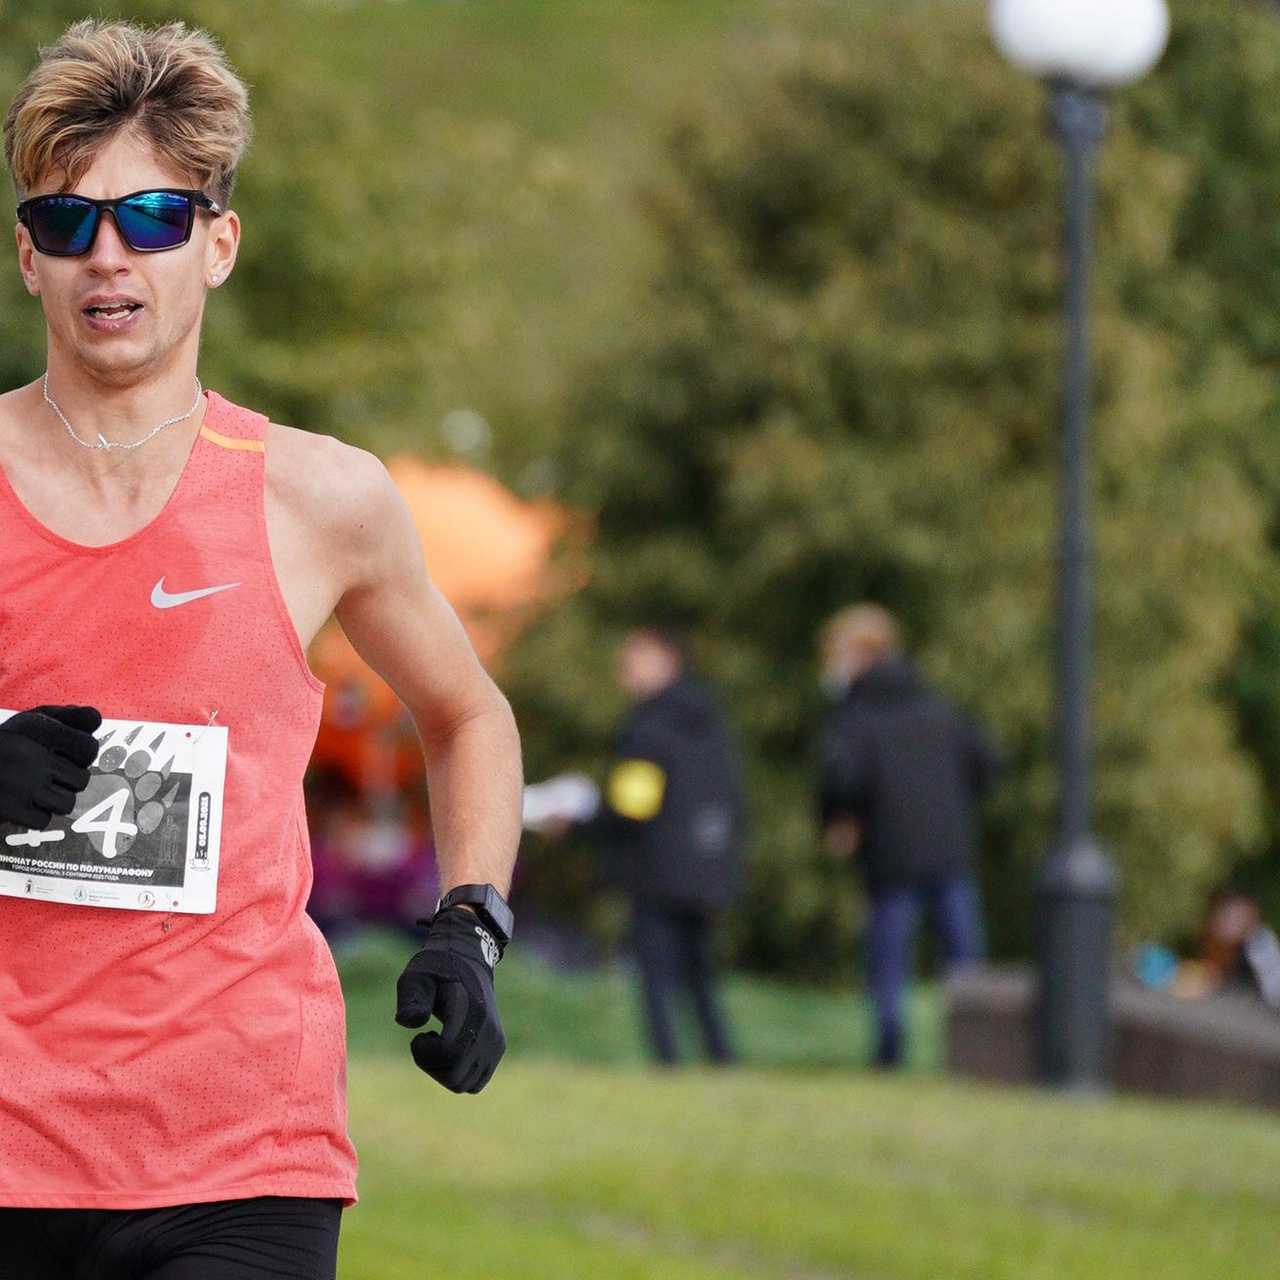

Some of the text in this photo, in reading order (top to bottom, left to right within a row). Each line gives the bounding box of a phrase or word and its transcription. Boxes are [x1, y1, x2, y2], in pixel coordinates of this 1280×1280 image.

[198, 796, 209, 847] 05.09.2021
[31, 859, 65, 870] РОССИИ
[66, 863, 79, 871] ПО
[80, 864, 154, 877] ПОЛУМАРАФОНУ
